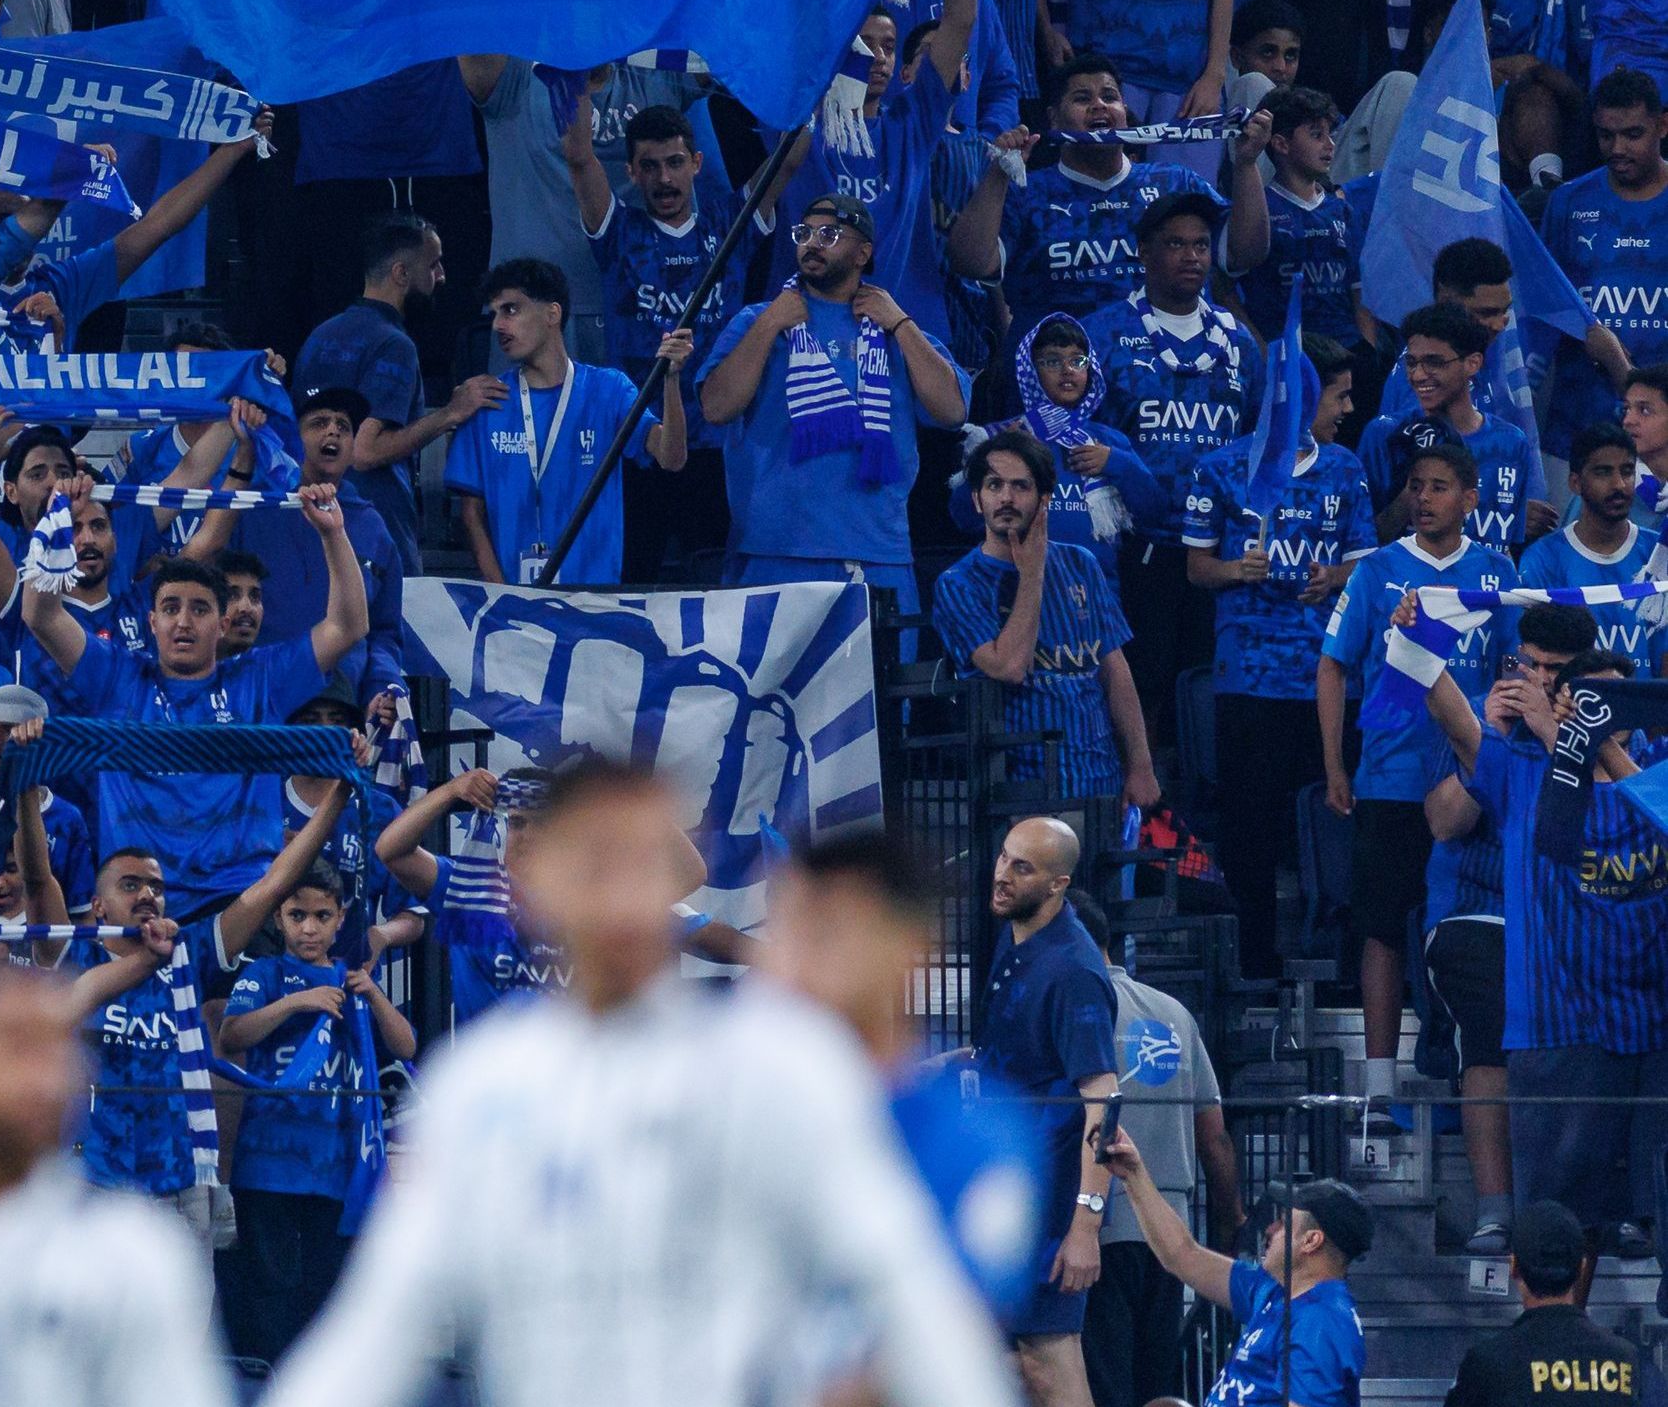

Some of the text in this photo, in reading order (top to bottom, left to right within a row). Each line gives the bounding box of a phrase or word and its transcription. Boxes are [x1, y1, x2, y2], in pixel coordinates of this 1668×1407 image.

[47, 78, 175, 124] كبير
[1101, 266, 1146, 281] GRO
[1139, 399, 1240, 432] SAVVY
[1139, 433, 1233, 447] GAMES GROU
[494, 953, 577, 989] SAVV
[103, 1003, 179, 1042] SAVV
[1530, 1360, 1632, 1394] POLICE
